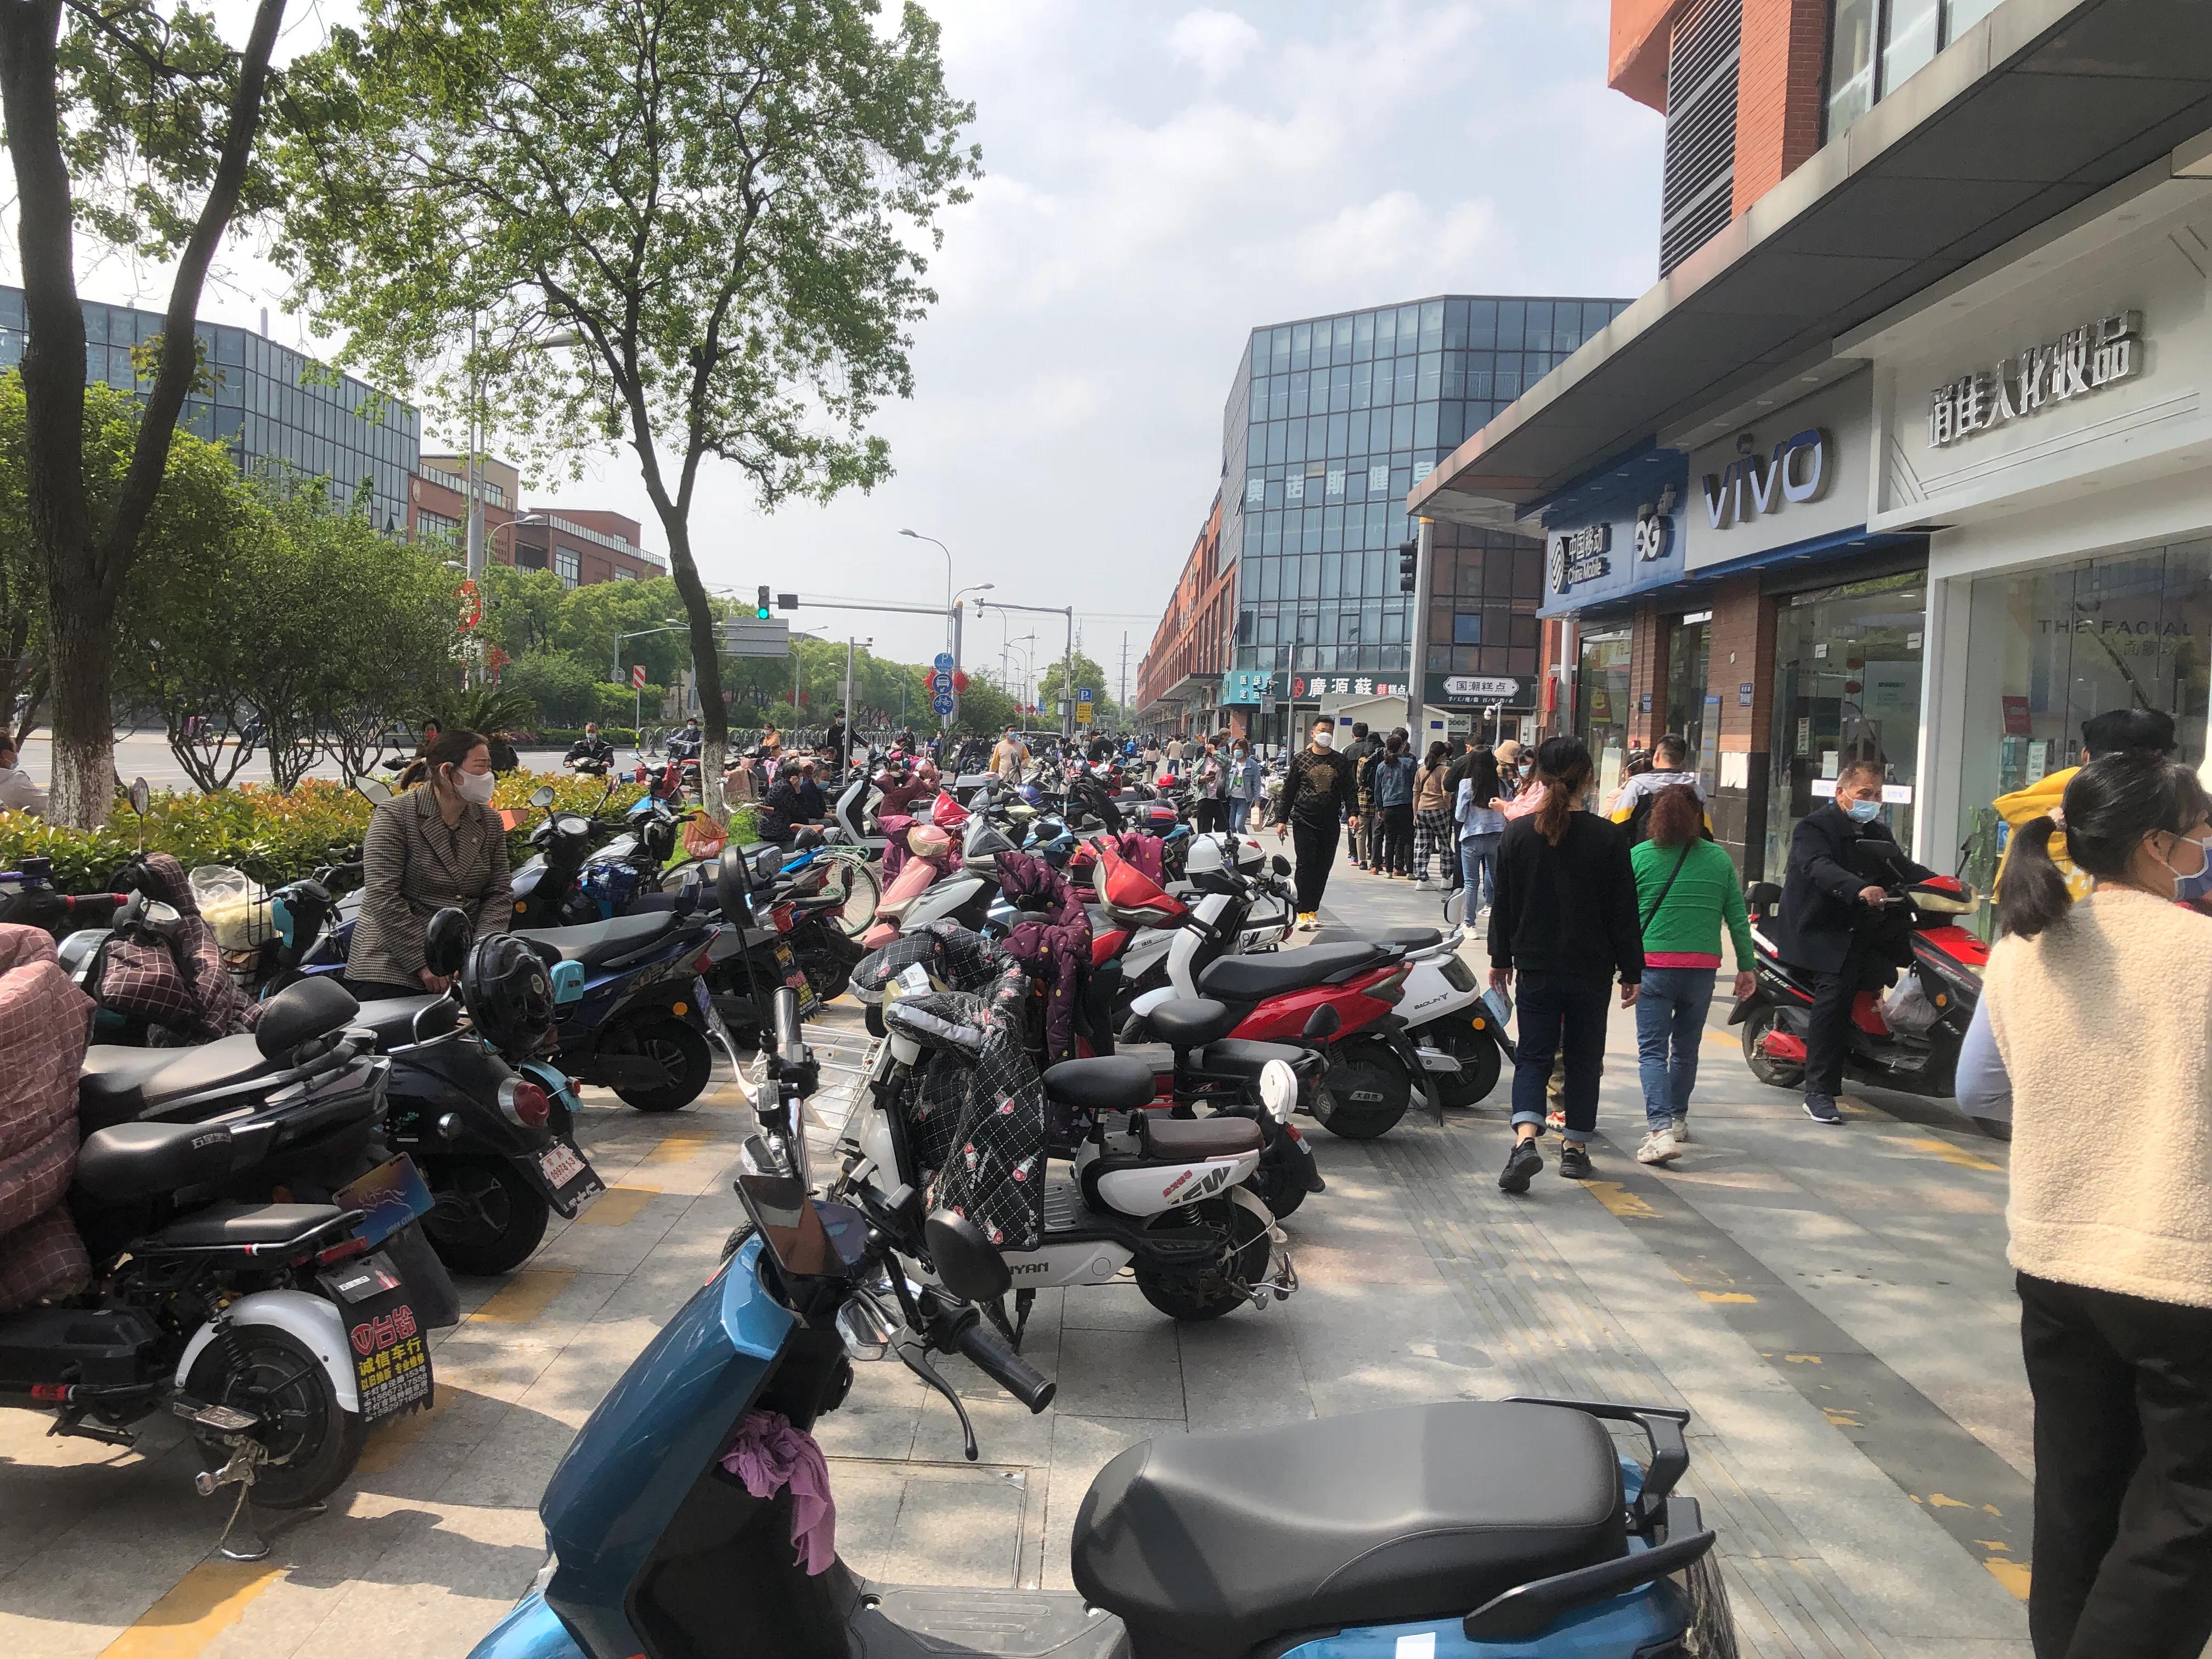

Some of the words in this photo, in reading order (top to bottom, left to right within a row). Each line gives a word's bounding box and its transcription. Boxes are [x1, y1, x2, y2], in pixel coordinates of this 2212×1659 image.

[1702, 428, 1822, 531] vivo
[1568, 524, 1607, 562] 中国移动
[1567, 565, 1584, 585] China
[2101, 620, 2191, 636] FACIAL
[1240, 675, 1261, 685] 医保
[1456, 681, 1506, 692] 国潮糕点
[373, 1305, 417, 1350] 台铃
[358, 1336, 421, 1376] 诚信车行
